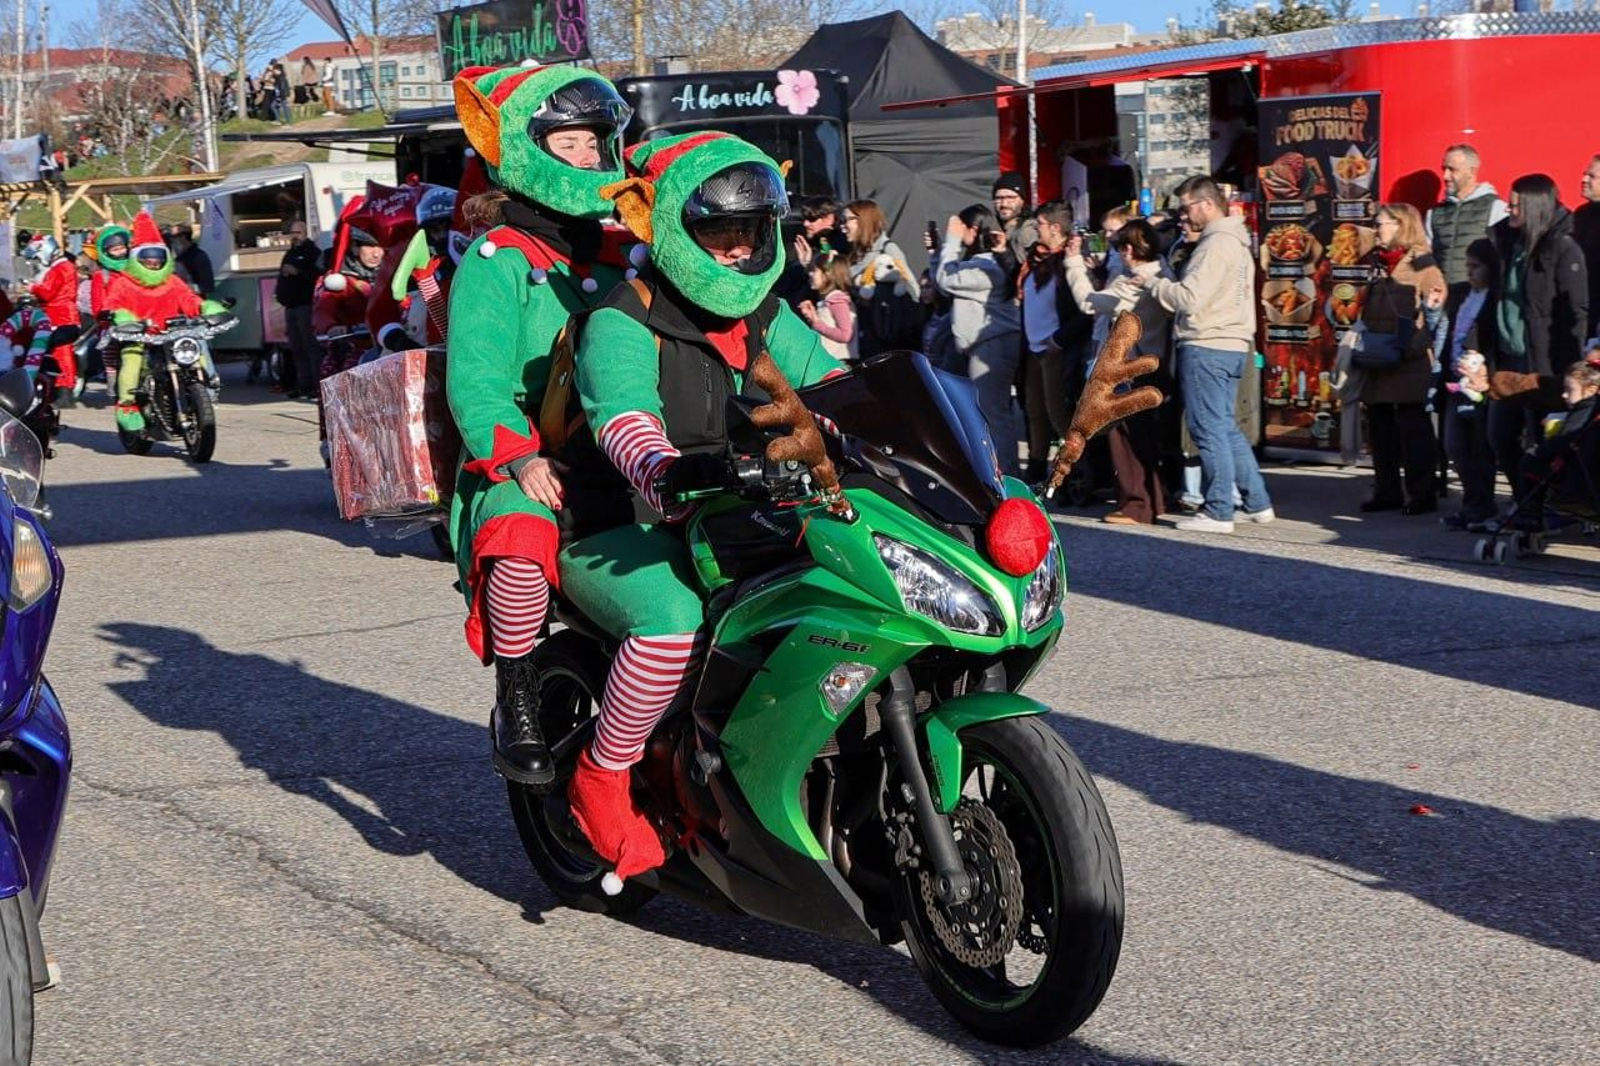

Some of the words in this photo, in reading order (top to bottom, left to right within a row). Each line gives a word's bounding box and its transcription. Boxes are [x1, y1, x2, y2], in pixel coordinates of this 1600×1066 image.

[671, 83, 697, 112] A
[697, 83, 732, 109] boa
[732, 81, 774, 106] vida
[1275, 121, 1315, 146] FOOD
[1315, 119, 1365, 142] TRUCK
